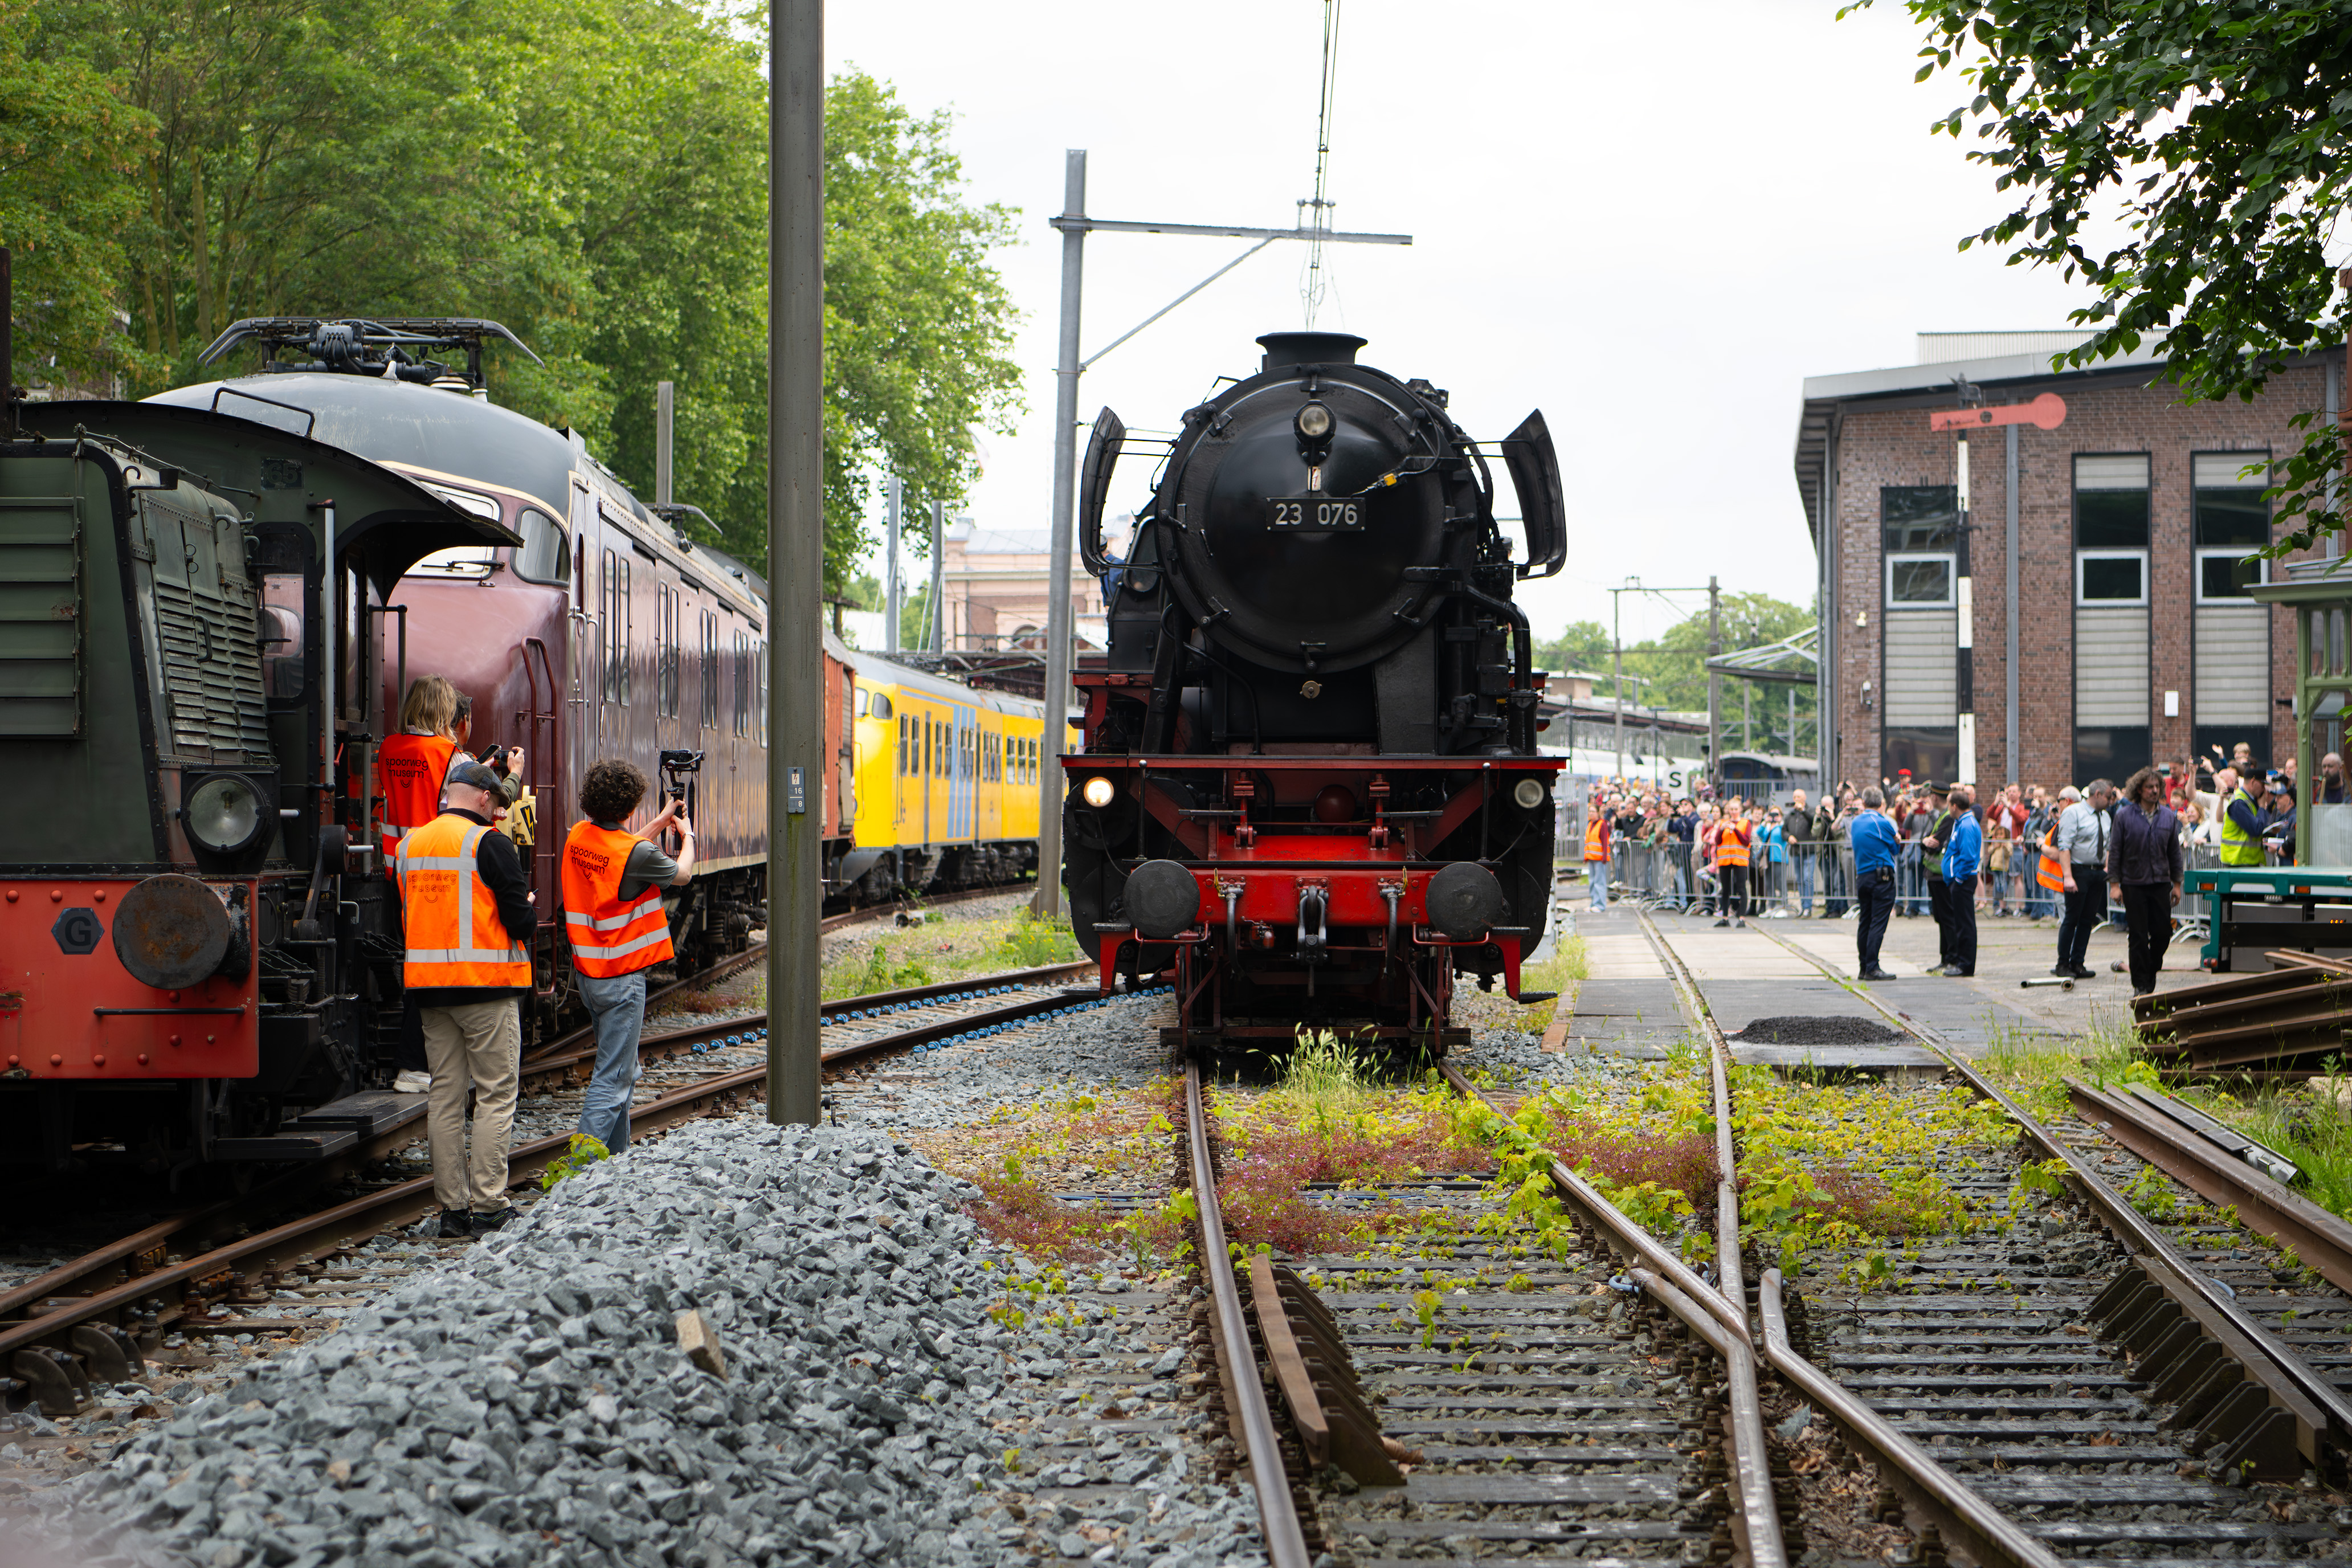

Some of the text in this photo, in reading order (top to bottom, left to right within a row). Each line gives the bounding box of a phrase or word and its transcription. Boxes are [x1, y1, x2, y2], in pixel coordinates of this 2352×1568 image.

[267, 462, 298, 484] 65
[1275, 503, 1358, 525] 23 076
[386, 758, 428, 771] spoorweg
[389, 769, 424, 779] museum
[1669, 771, 1681, 787] S
[570, 845, 610, 867] spoorweg
[571, 856, 605, 875] museum
[407, 873, 457, 885] spoorweg
[65, 916, 91, 946] G
